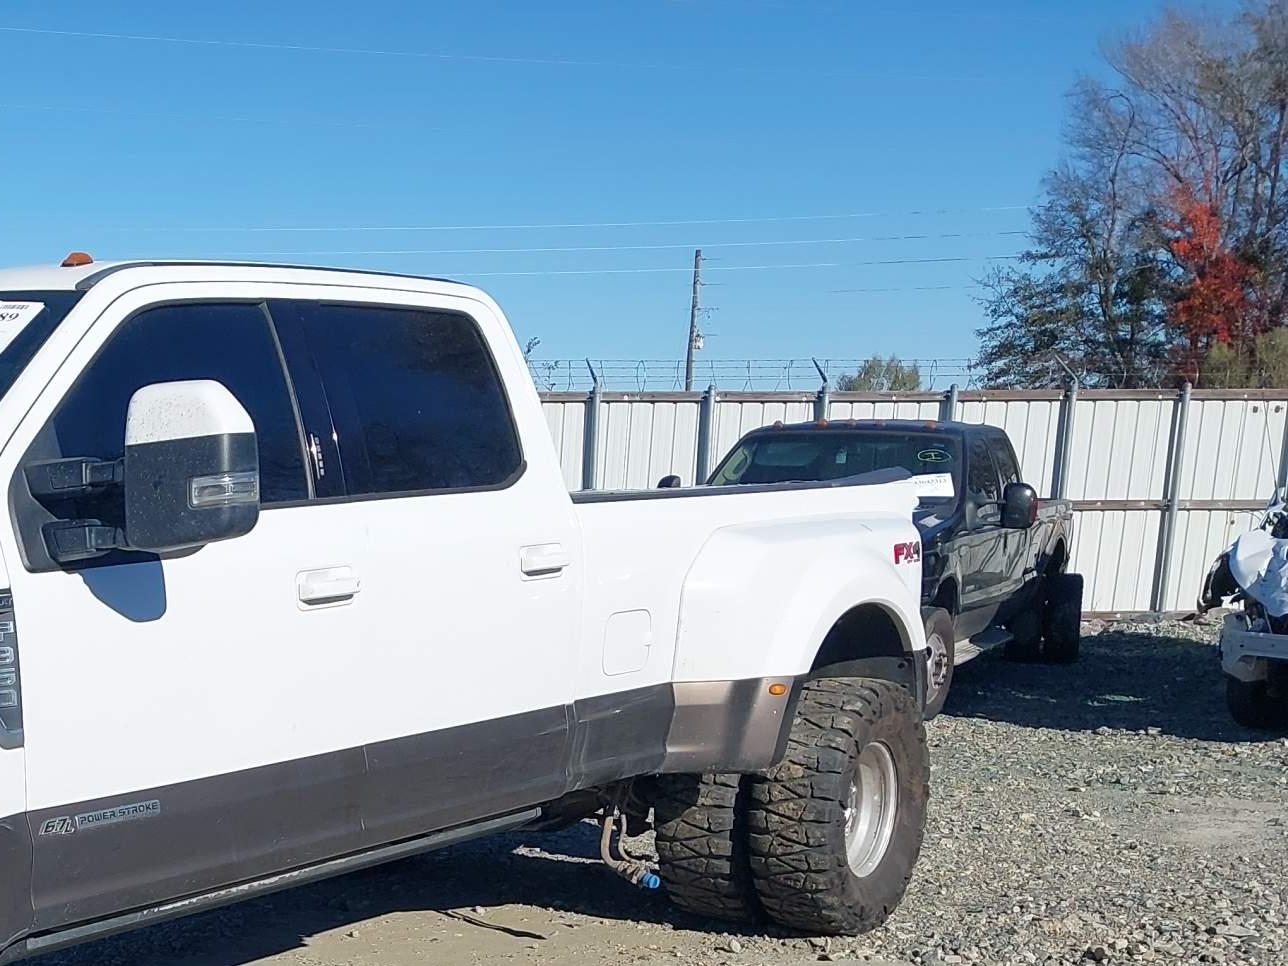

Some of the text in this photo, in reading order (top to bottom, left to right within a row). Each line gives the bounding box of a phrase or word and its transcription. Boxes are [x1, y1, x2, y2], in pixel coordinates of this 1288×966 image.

[893, 541, 921, 564] FX4
[78, 810, 117, 826] POWER
[118, 800, 160, 817] STROKE
